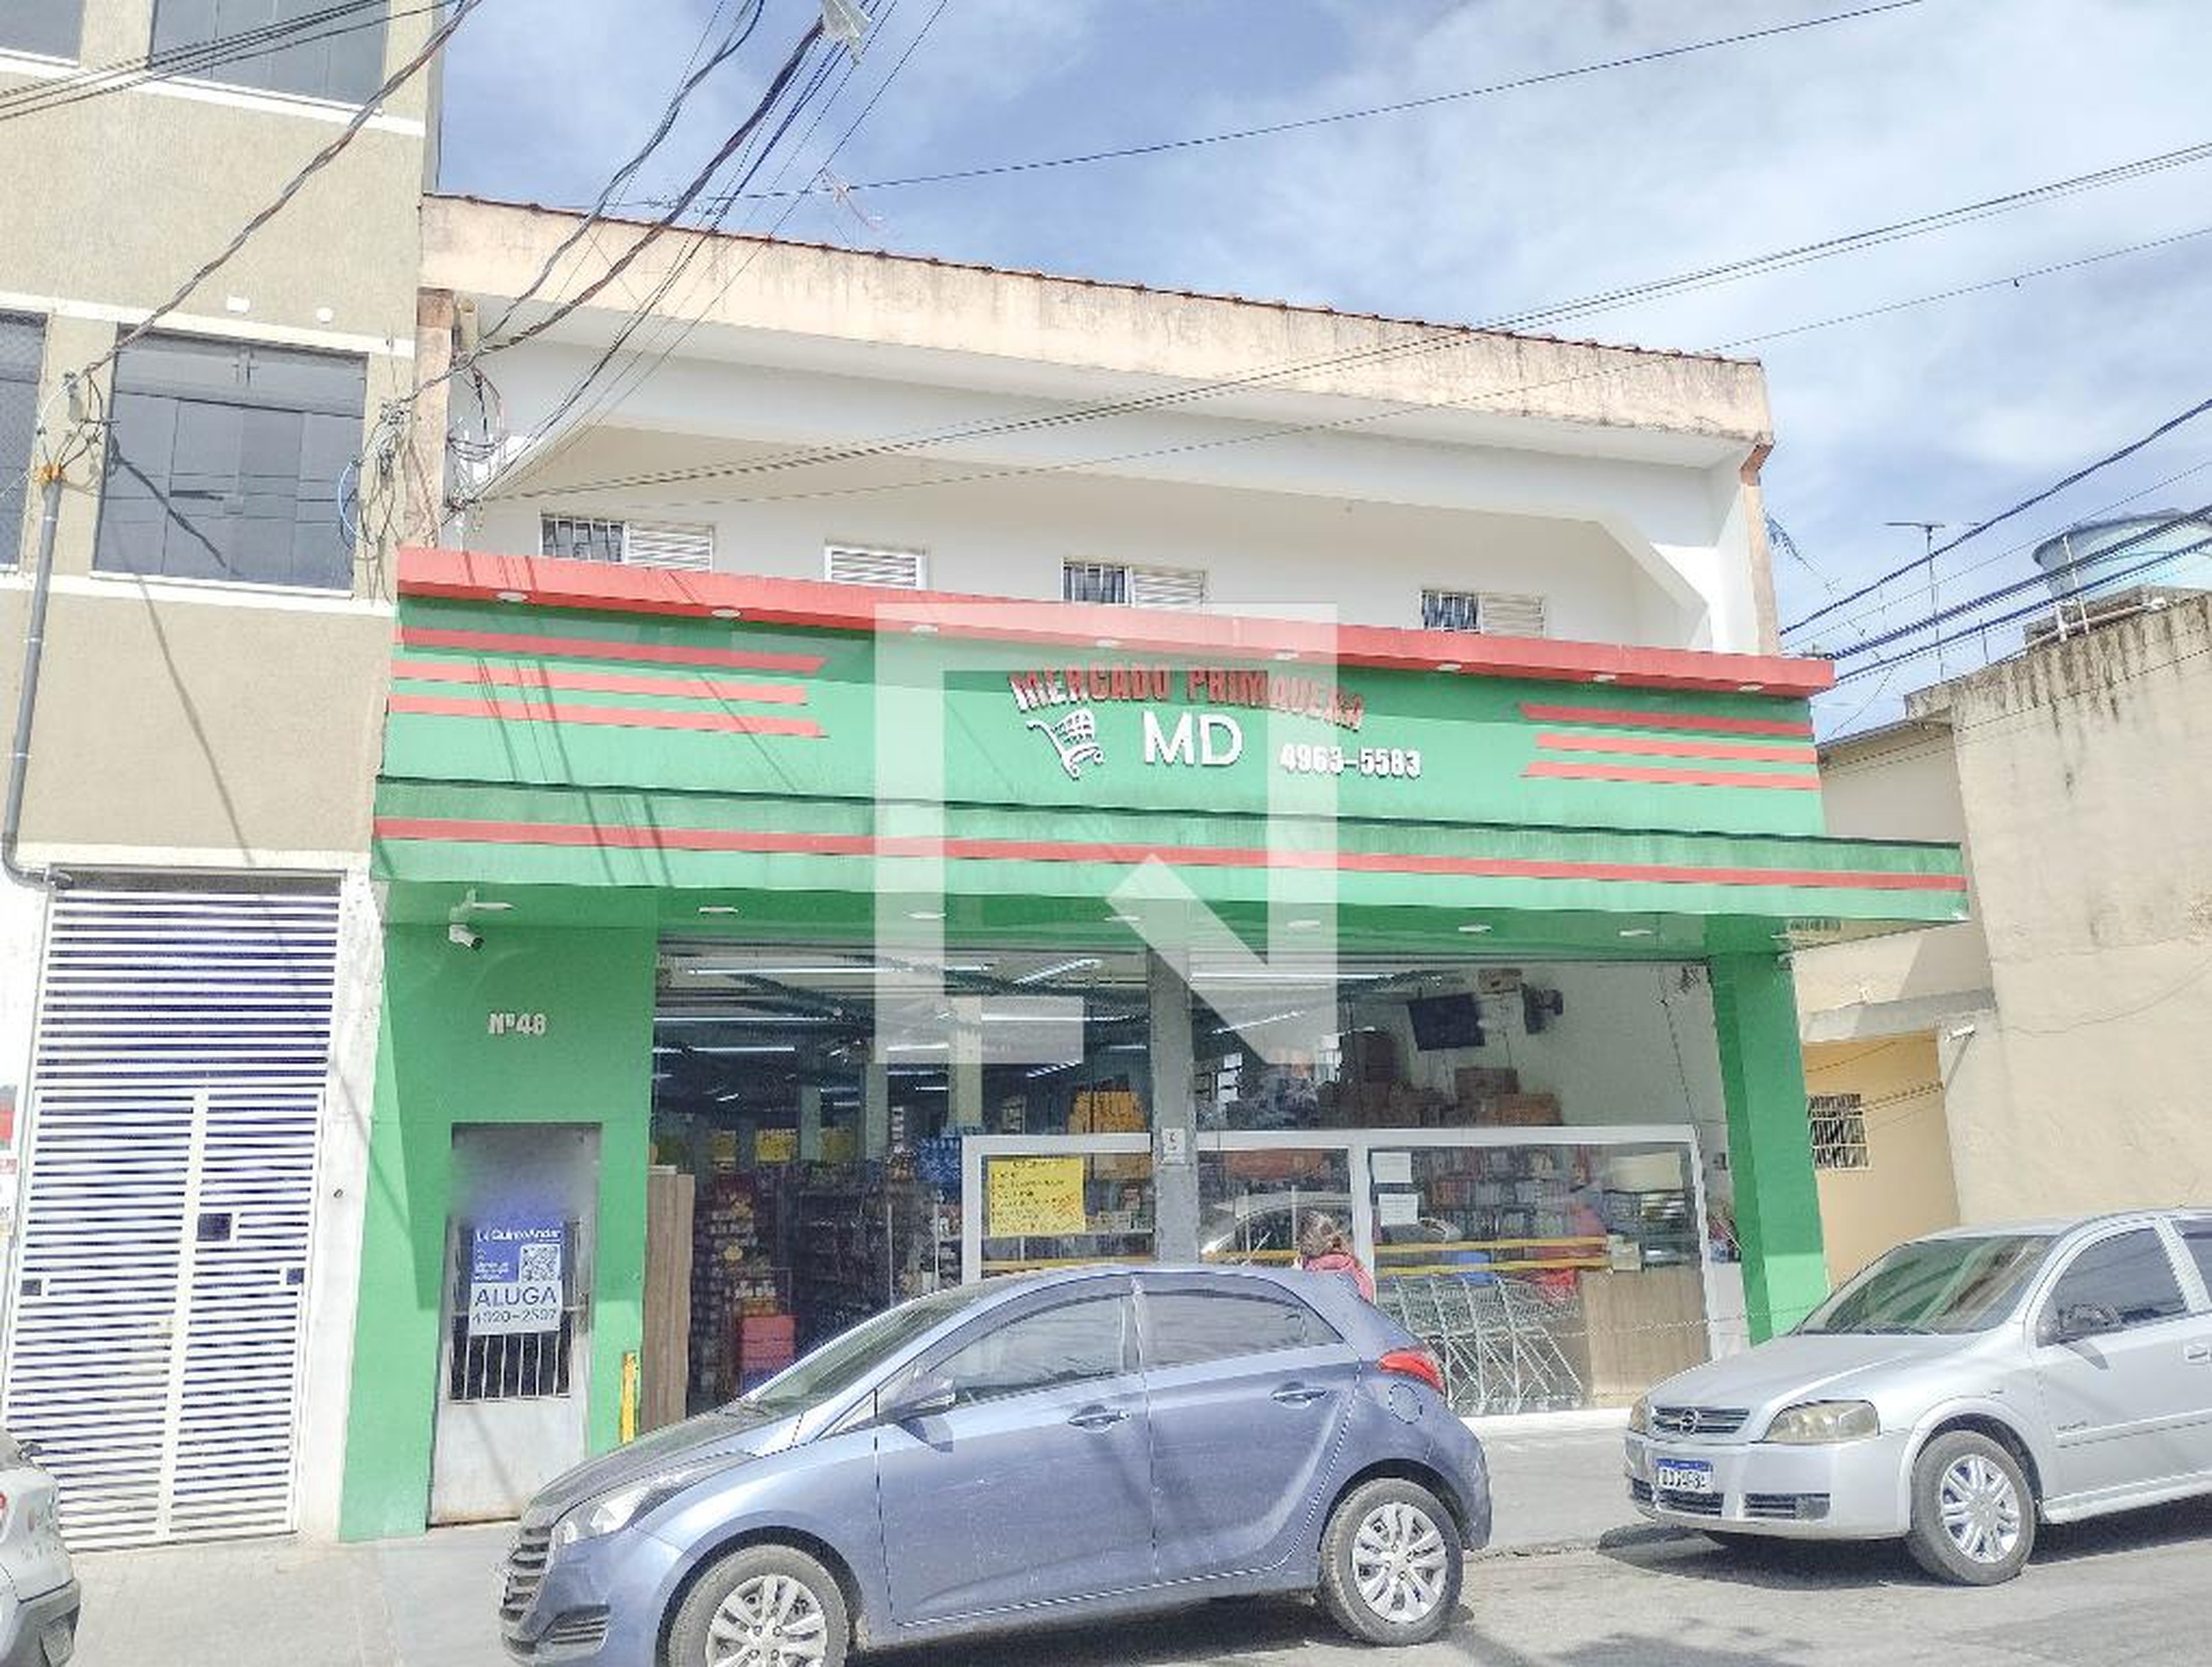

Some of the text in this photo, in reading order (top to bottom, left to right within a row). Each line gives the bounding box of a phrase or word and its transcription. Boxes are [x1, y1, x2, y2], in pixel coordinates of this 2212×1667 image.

[1009, 661, 1364, 732] MERCADO PRIMAVERA
[1143, 711, 1244, 767] MD
[1280, 743, 1421, 779] 4963-5583
[474, 1286, 558, 1307] ALUGA
